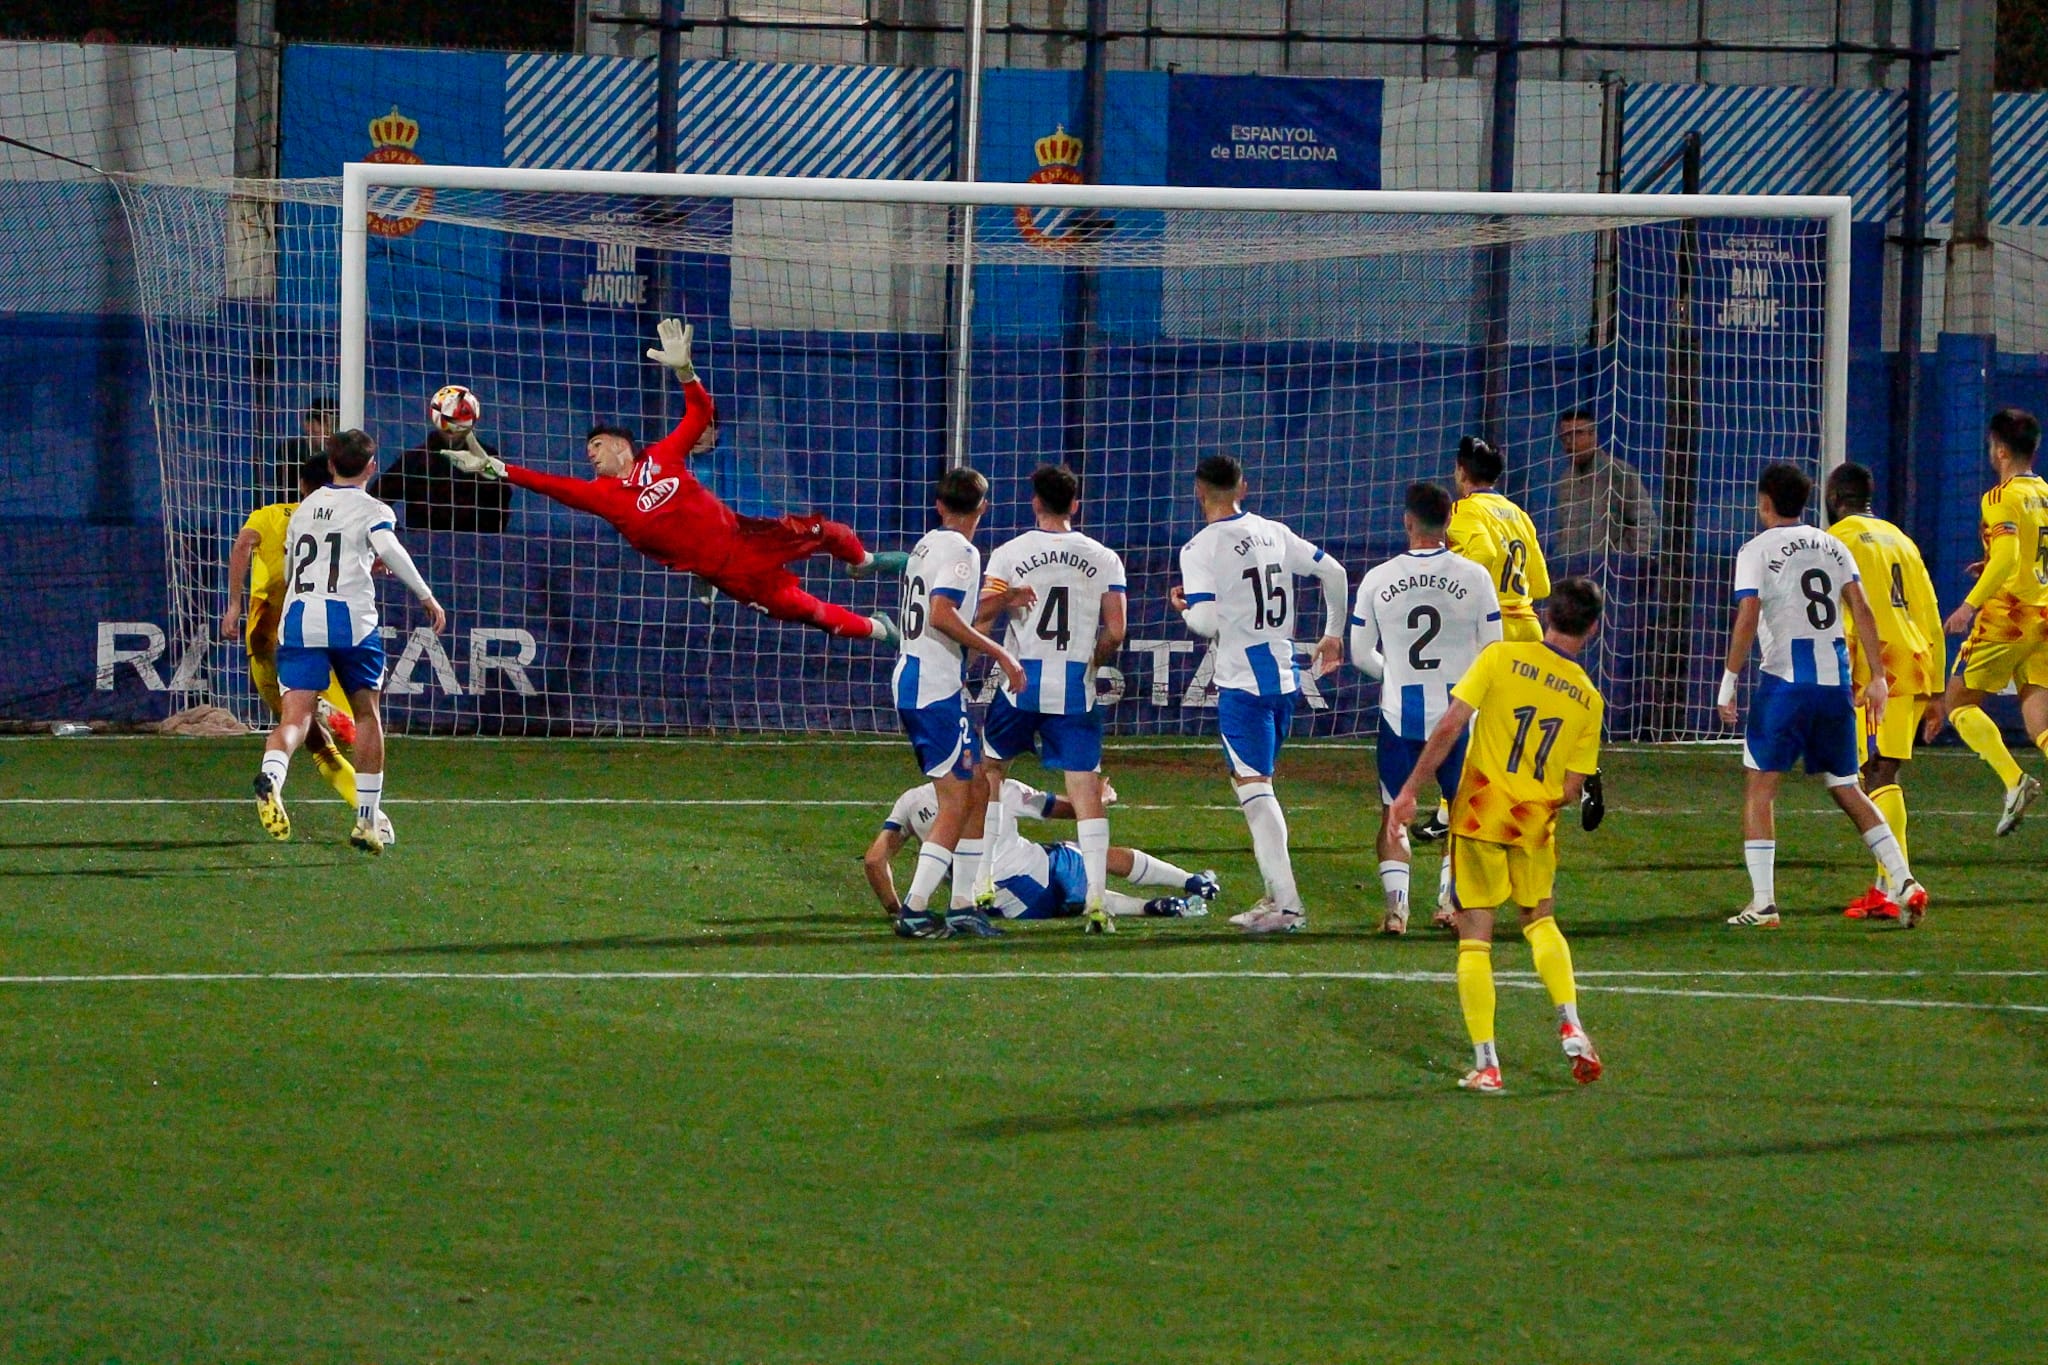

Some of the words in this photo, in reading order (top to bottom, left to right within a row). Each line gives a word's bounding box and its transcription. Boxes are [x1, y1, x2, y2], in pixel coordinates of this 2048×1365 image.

[1231, 125, 1318, 143] ESPANYOL
[1210, 144, 1231, 159] de
[1235, 144, 1339, 161] BARCELONA
[597, 241, 637, 273] DANI
[582, 273, 648, 308] JARQUE
[1732, 267, 1768, 296] DANI
[1718, 299, 1780, 332] JARQUE
[640, 482, 673, 510] DANI
[313, 507, 333, 520] IAN
[295, 532, 342, 595] 21
[1015, 551, 1098, 578] ALEJANDRO
[1768, 559, 1786, 574] M.
[1242, 563, 1287, 630] 15
[1380, 574, 1468, 602] CASADESÚS
[1801, 568, 1837, 630] 8
[1891, 563, 1909, 611] 4
[1036, 586, 1071, 651] 4
[1407, 605, 1442, 670] 2
[1511, 659, 1540, 681] TON
[1544, 673, 1592, 711] RIPOLL
[1506, 705, 1564, 783] 11
[918, 806, 936, 823] M.
